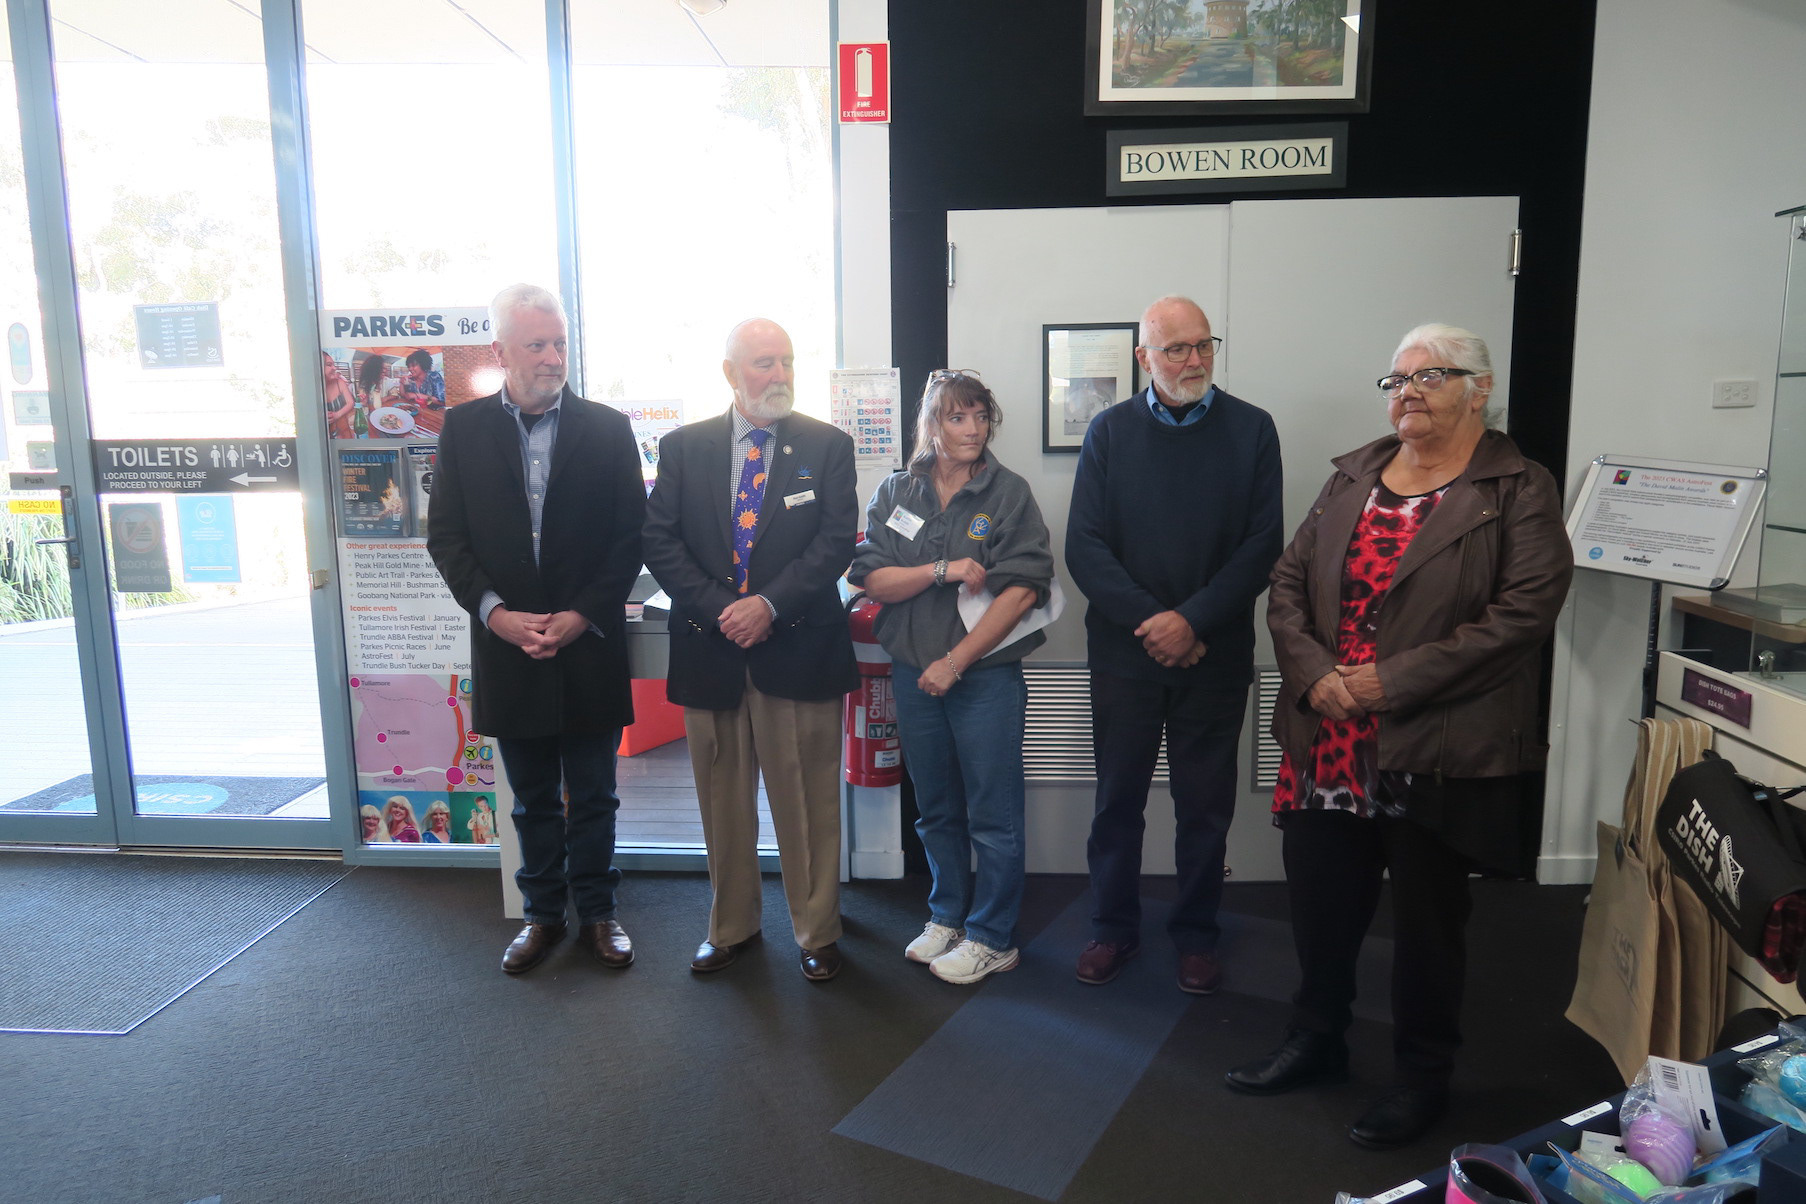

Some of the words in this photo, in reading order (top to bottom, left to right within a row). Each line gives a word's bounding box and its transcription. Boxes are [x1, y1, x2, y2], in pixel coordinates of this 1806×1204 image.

[1125, 149, 1231, 175] BOWEN
[1239, 145, 1328, 170] ROOM
[333, 314, 445, 338] PARKES
[457, 318, 478, 335] Be
[621, 407, 680, 421] bleHelix
[107, 446, 199, 467] TOILETS
[341, 454, 396, 463] DISCOVER
[24, 477, 45, 485] Push
[103, 472, 138, 480] LOCATED
[140, 471, 175, 480] OUTSIDE,
[177, 471, 207, 479] PLEASE
[110, 482, 146, 490] PROCEED
[148, 481, 159, 489] TO
[160, 481, 182, 489] YOUR
[183, 481, 202, 489] LEFT
[357, 592, 388, 600] Goobang
[432, 662, 445, 670] Day
[453, 662, 472, 670] Septe
[1699, 680, 1709, 688] DISH
[1710, 684, 1723, 694] TOTE
[1724, 690, 1736, 699] BAGS
[1689, 799, 1720, 851] THE
[1676, 815, 1713, 873] DISH
